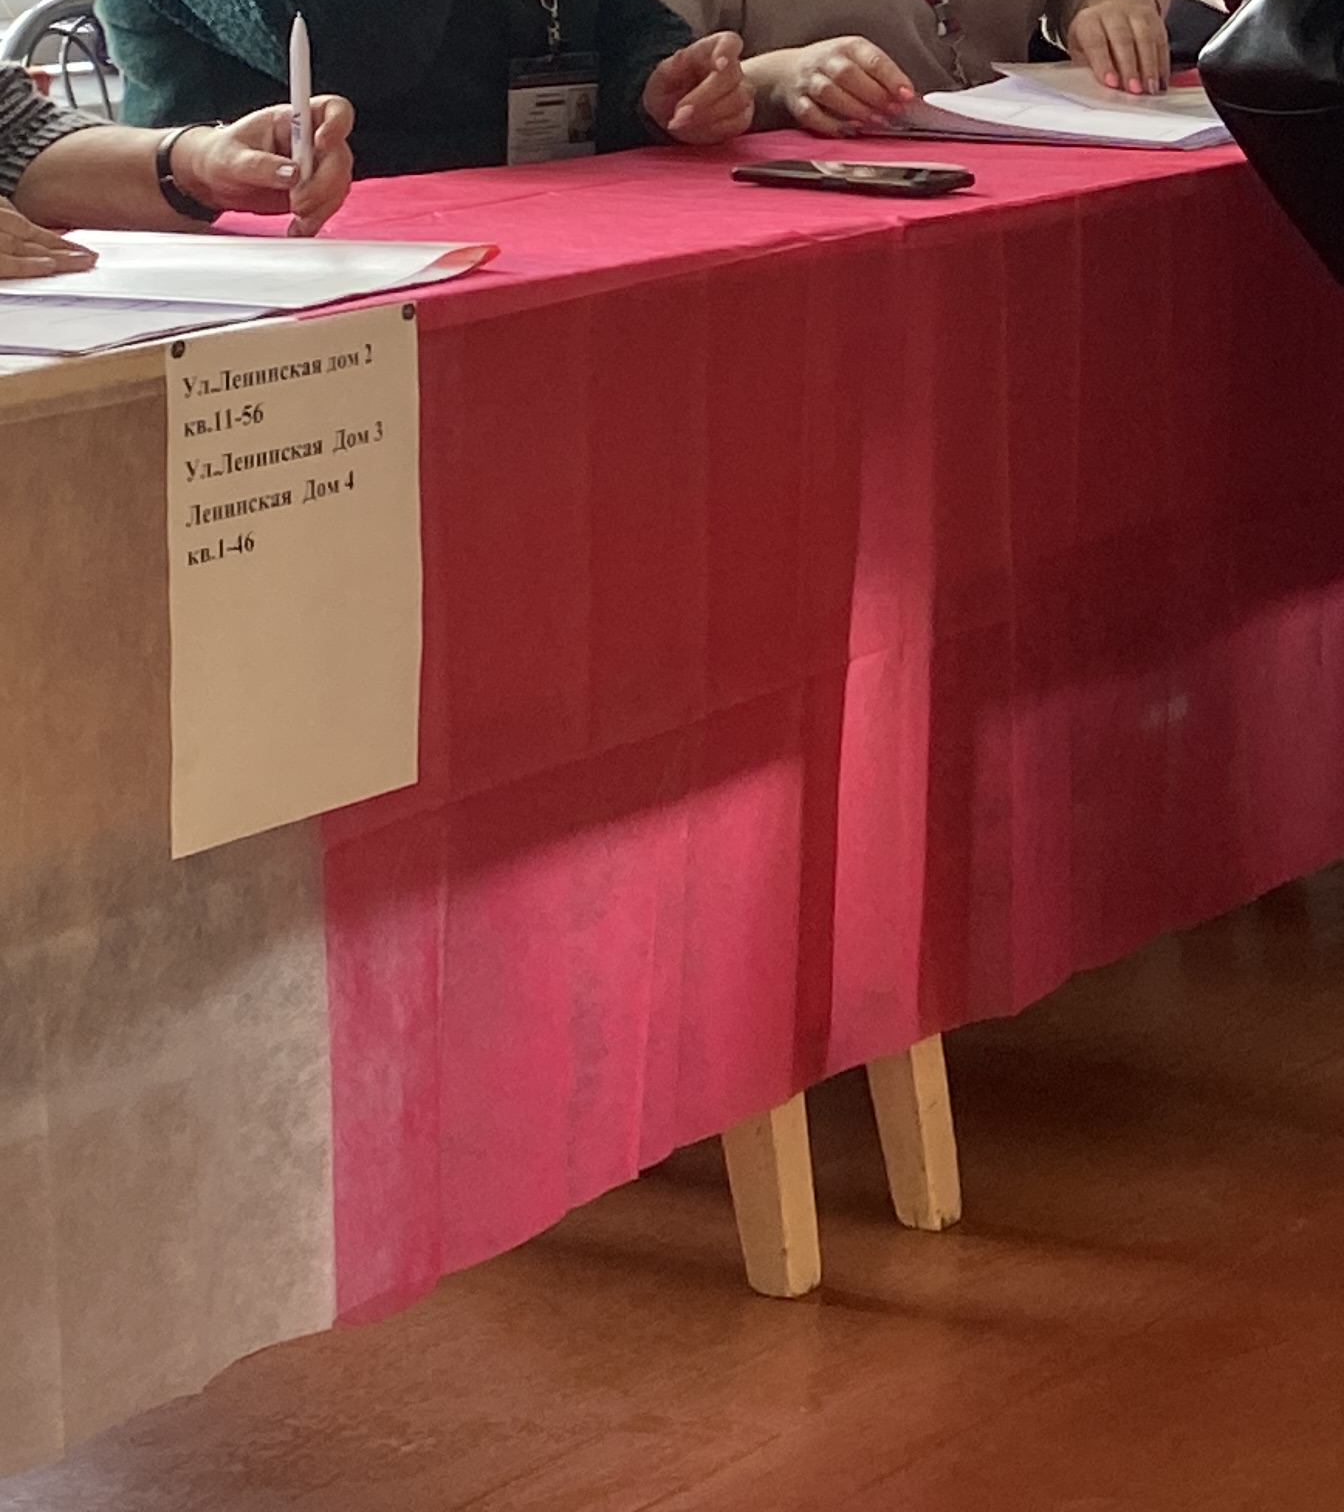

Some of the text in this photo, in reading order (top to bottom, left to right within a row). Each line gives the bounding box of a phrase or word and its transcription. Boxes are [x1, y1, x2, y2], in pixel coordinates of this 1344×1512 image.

[326, 351, 360, 373] дом
[364, 343, 374, 365] 2
[184, 402, 265, 438] кв.11-56
[332, 428, 370, 453] Дом
[373, 420, 384, 442] 3
[185, 470, 355, 528] Ленинская Дом 4
[187, 531, 256, 566] кв.1-46
